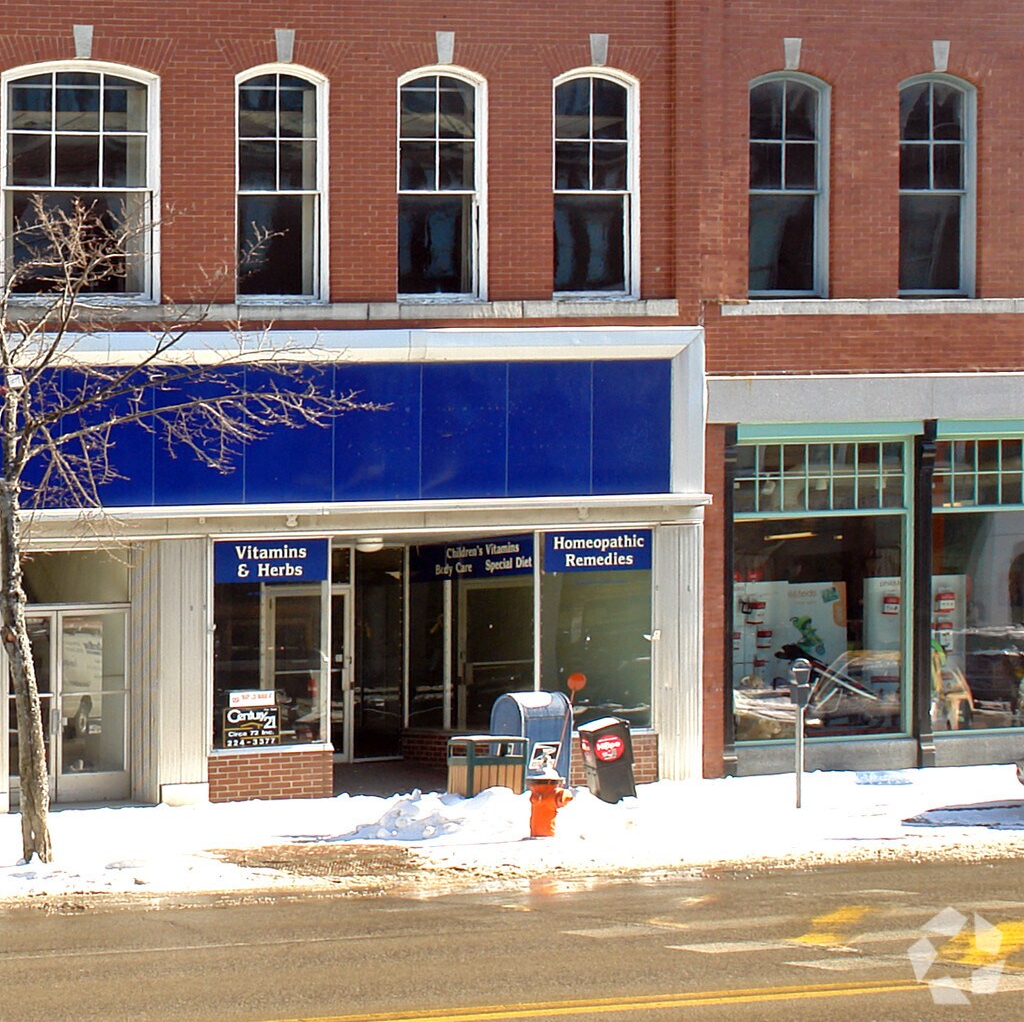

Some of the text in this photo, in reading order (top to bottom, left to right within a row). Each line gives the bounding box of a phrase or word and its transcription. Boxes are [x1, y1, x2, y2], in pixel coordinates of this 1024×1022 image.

[446, 542, 520, 559] Children's Vitamins
[553, 535, 645, 552] Homeopathic
[235, 544, 307, 559] Vitamins
[435, 555, 533, 576] Body Care Special Diet
[565, 552, 634, 567] Remedies
[237, 563, 303, 577] & Herbs
[227, 709, 268, 723] Century
[264, 716, 277, 729] 21
